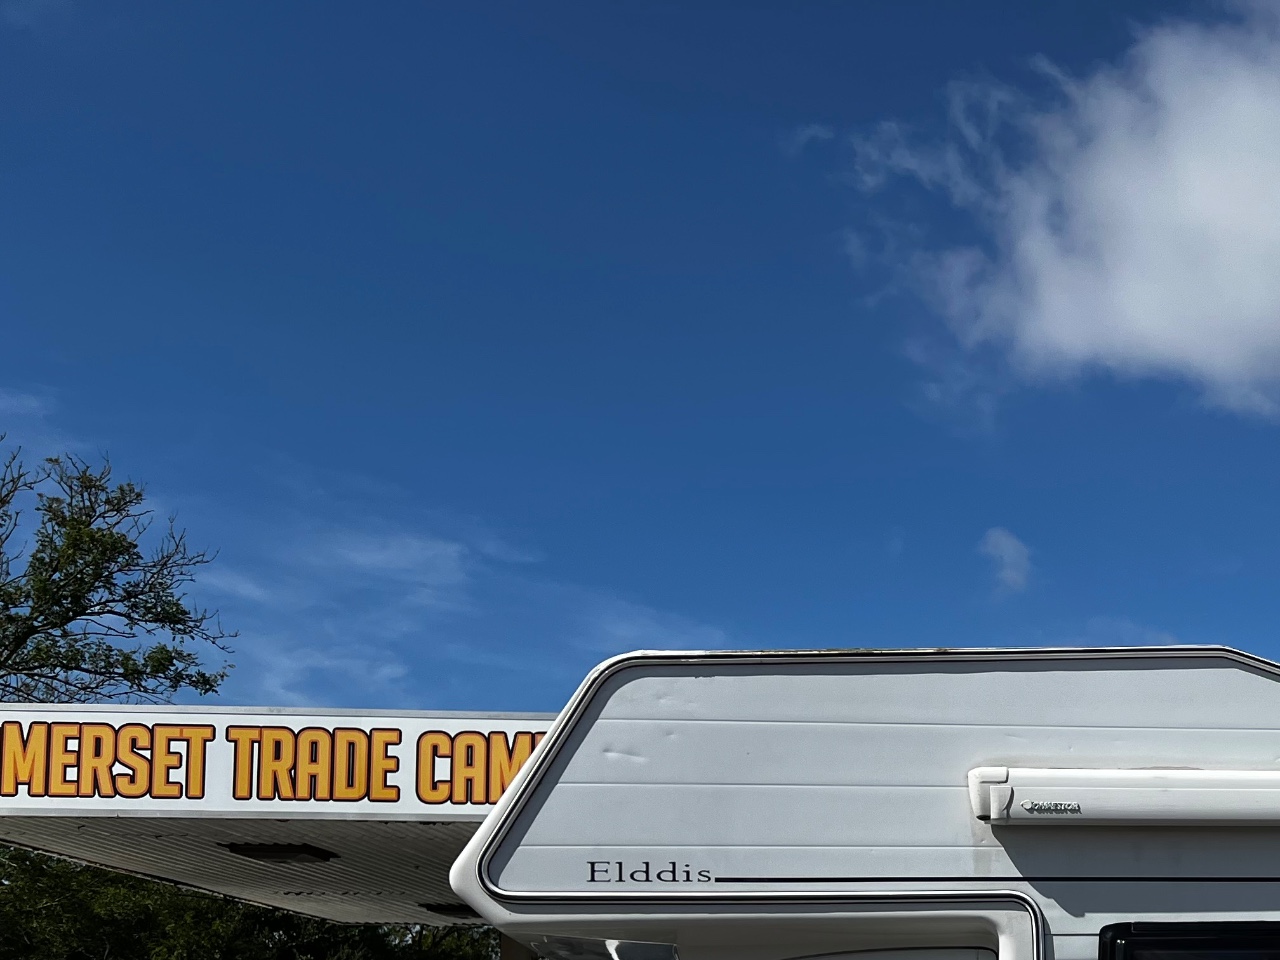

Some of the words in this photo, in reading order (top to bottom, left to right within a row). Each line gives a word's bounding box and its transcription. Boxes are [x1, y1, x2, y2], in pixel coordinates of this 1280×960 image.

[0, 721, 216, 799] MERSET
[226, 725, 402, 802] TRADE
[416, 730, 550, 805] CAM
[586, 861, 712, 883] Elddis
